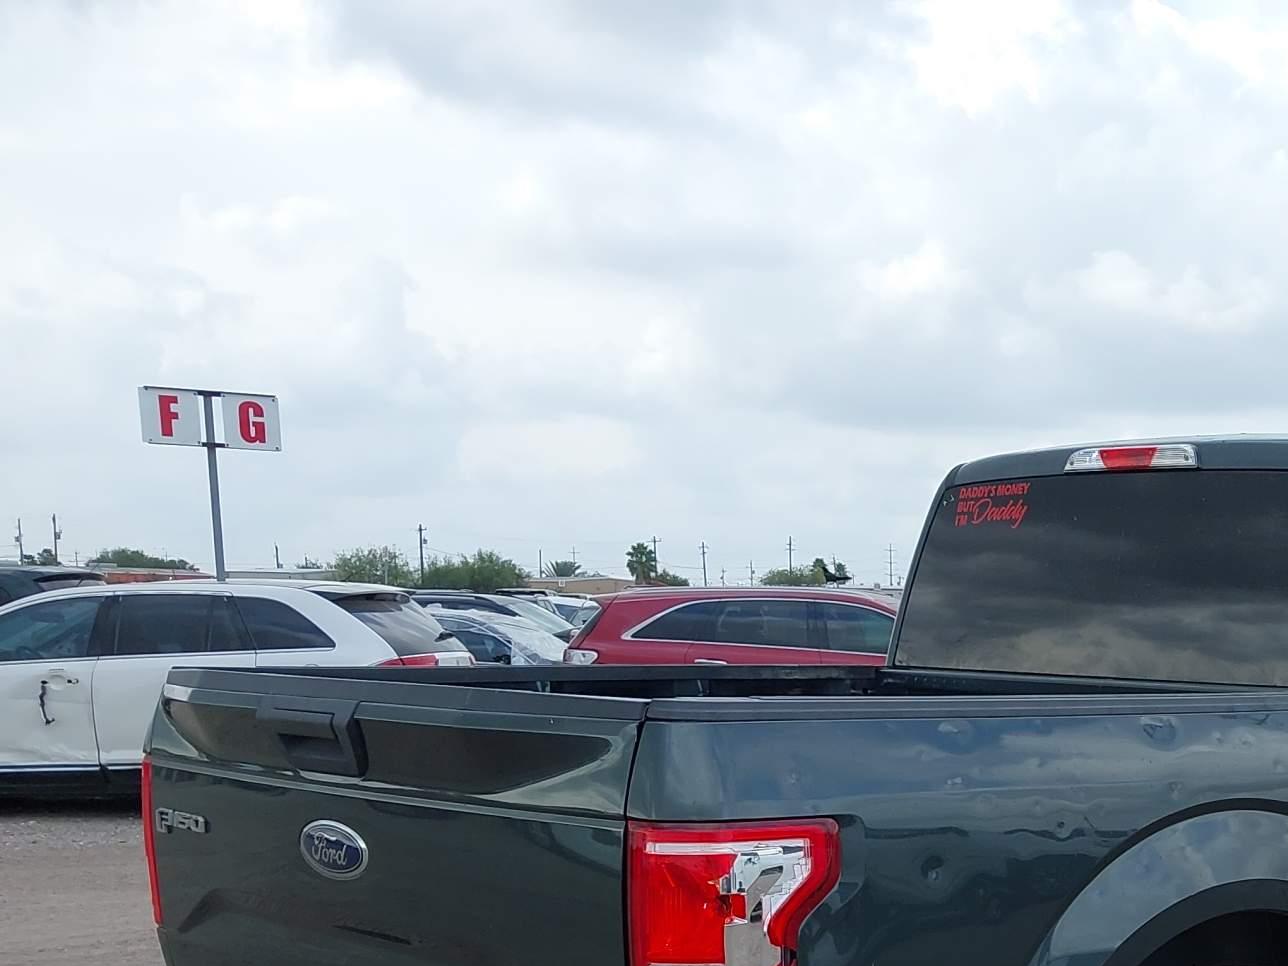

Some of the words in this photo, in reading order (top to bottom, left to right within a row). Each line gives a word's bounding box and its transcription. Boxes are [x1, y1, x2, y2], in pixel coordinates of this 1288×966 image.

[158, 394, 179, 437] F
[238, 400, 267, 444] G
[997, 482, 1031, 496] MONEY
[971, 498, 1028, 529] Daddy
[311, 831, 348, 866] Ford
